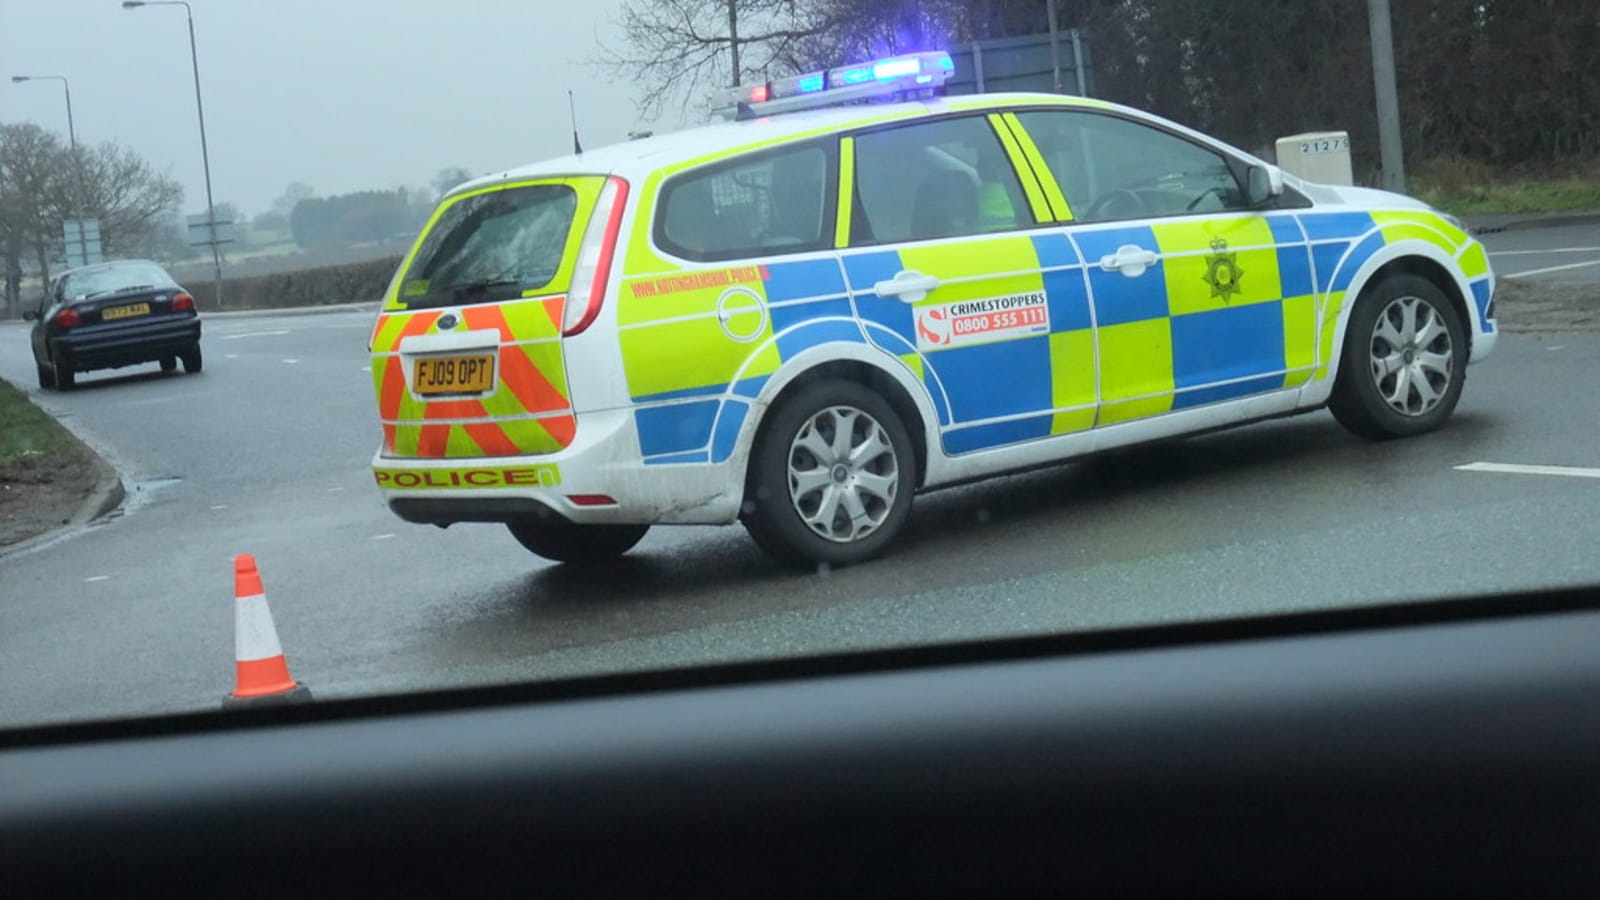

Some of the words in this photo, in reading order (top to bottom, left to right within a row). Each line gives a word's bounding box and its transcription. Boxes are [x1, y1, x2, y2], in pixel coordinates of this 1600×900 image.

[950, 293, 1045, 316] CRIMESTOPPERS
[954, 316, 990, 334] 0800
[993, 312, 1018, 328] 555
[1021, 308, 1045, 324] 111
[417, 360, 456, 387] FJ09
[458, 358, 488, 384] OPT
[374, 469, 539, 488] POLICE
